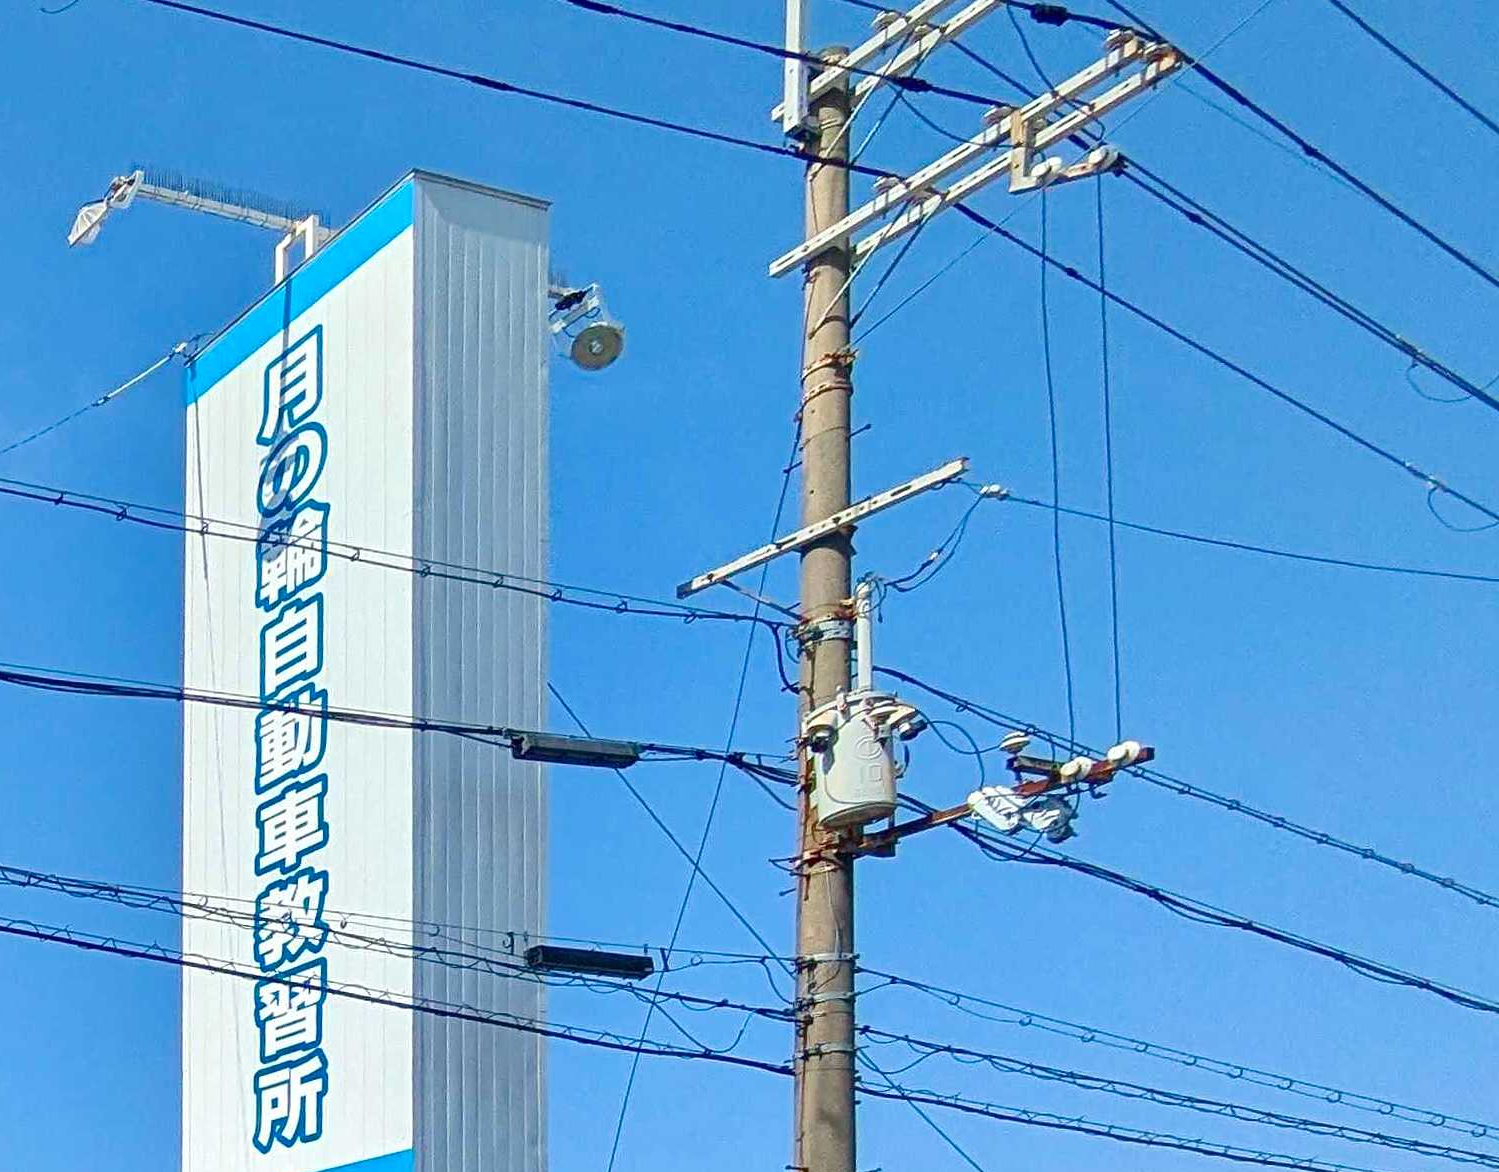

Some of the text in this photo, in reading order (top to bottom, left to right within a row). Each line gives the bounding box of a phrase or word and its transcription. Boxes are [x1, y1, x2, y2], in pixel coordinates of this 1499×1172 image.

[253, 324, 330, 1155] 月の輪自動車教習所
